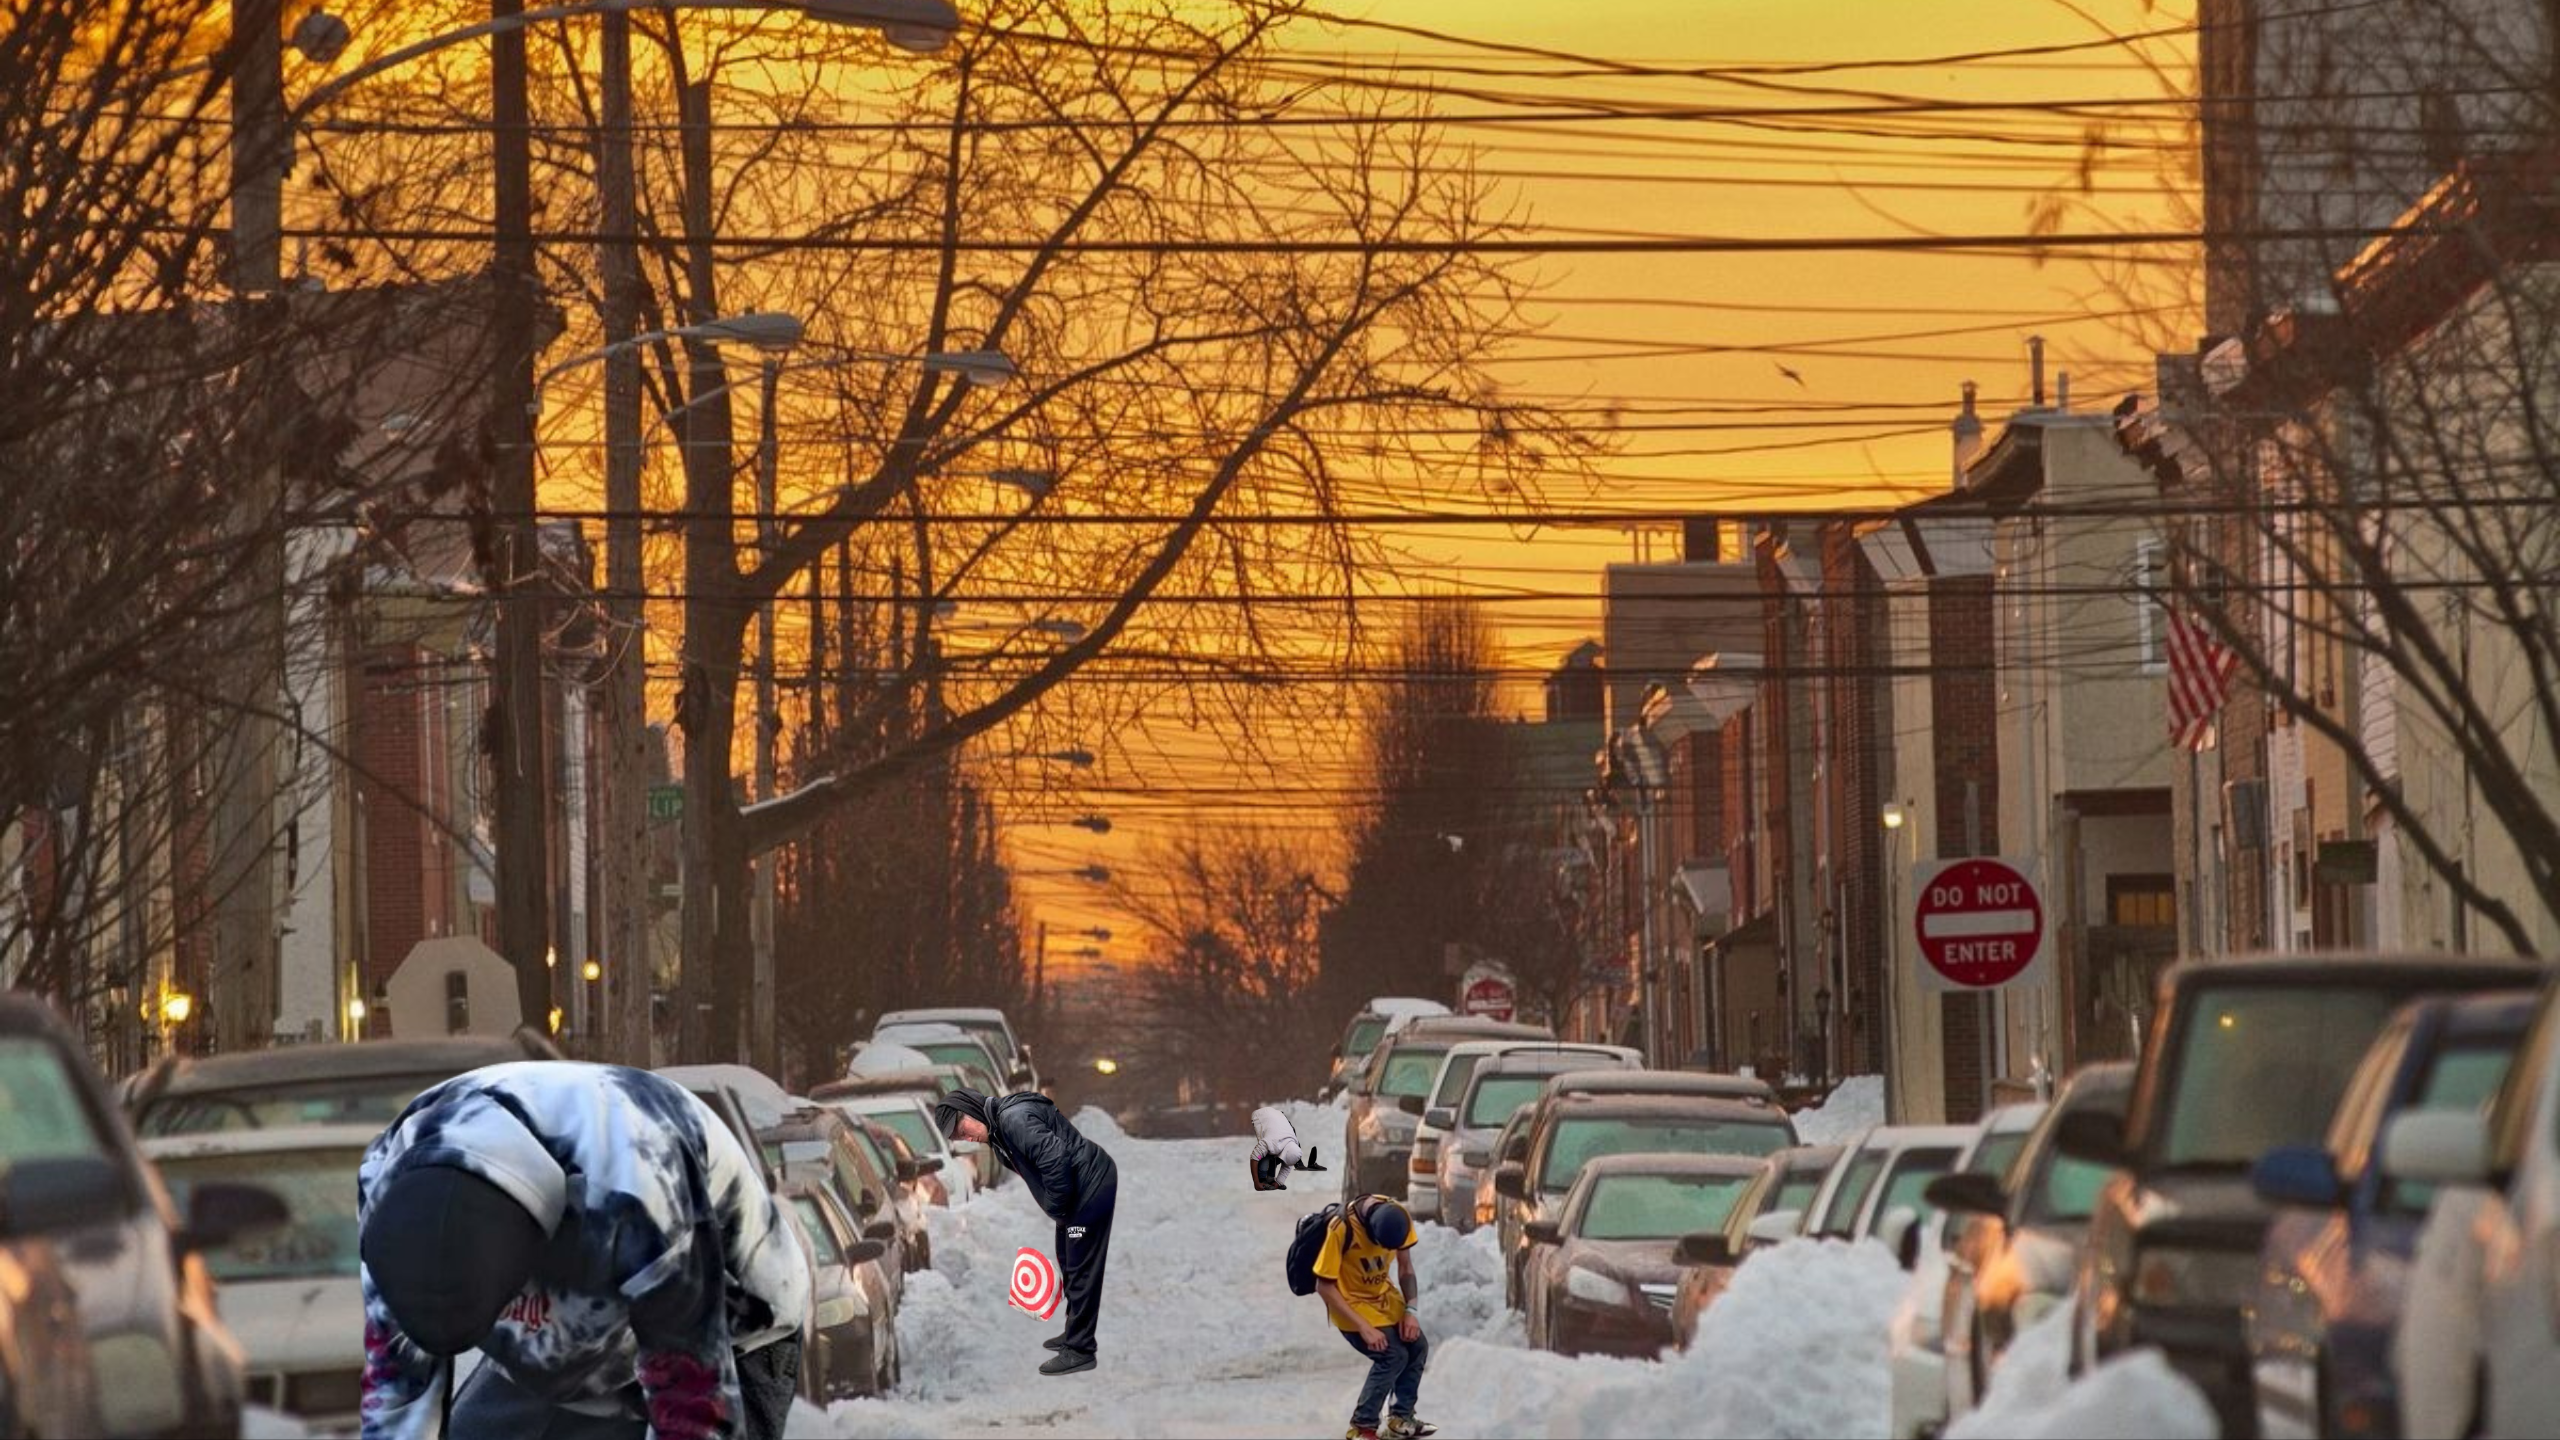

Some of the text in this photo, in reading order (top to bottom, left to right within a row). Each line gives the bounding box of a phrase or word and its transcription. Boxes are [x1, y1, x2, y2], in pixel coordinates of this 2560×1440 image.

[1932, 883, 2022, 907] DO NOT
[1944, 940, 2016, 964] ENTER
